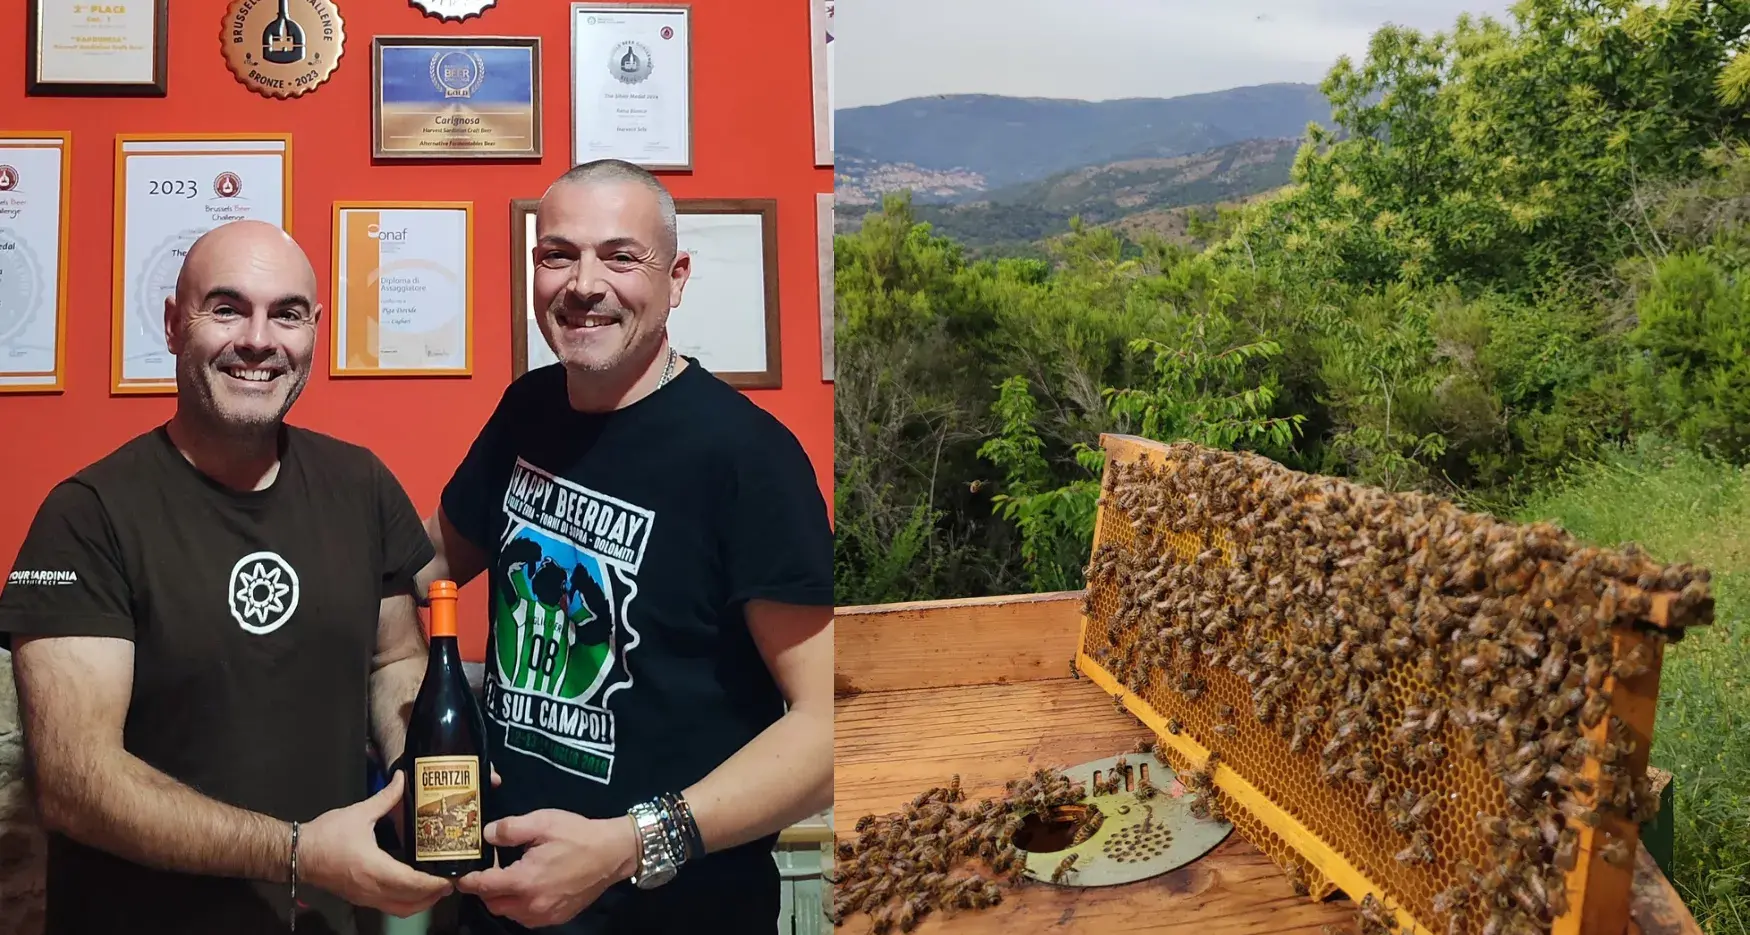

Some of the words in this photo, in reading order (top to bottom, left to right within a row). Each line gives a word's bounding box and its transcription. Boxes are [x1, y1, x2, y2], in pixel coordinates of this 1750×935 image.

[233, 0, 259, 43] BRUSSEL
[306, 0, 333, 41] ALLENGE
[249, 69, 284, 88] BRONZE
[295, 70, 319, 86] 2023
[445, 69, 469, 78] BEER
[435, 115, 480, 126] Carignosa
[149, 180, 198, 199] 2023
[205, 204, 232, 212] Brussels
[378, 228, 408, 241] onaf
[171, 249, 187, 257] The
[381, 277, 411, 285] Diploma
[381, 285, 427, 293] Assaggiatore
[510, 466, 554, 511] HAPPY
[555, 487, 645, 547] BEERDAY
[540, 512, 561, 531] FORNI
[560, 520, 569, 534] DI
[594, 538, 635, 563] DOLOMITI
[528, 633, 559, 677] 08
[502, 692, 534, 725] SUL
[539, 700, 608, 742] CAMPO!
[422, 770, 470, 787] GERATZIA
